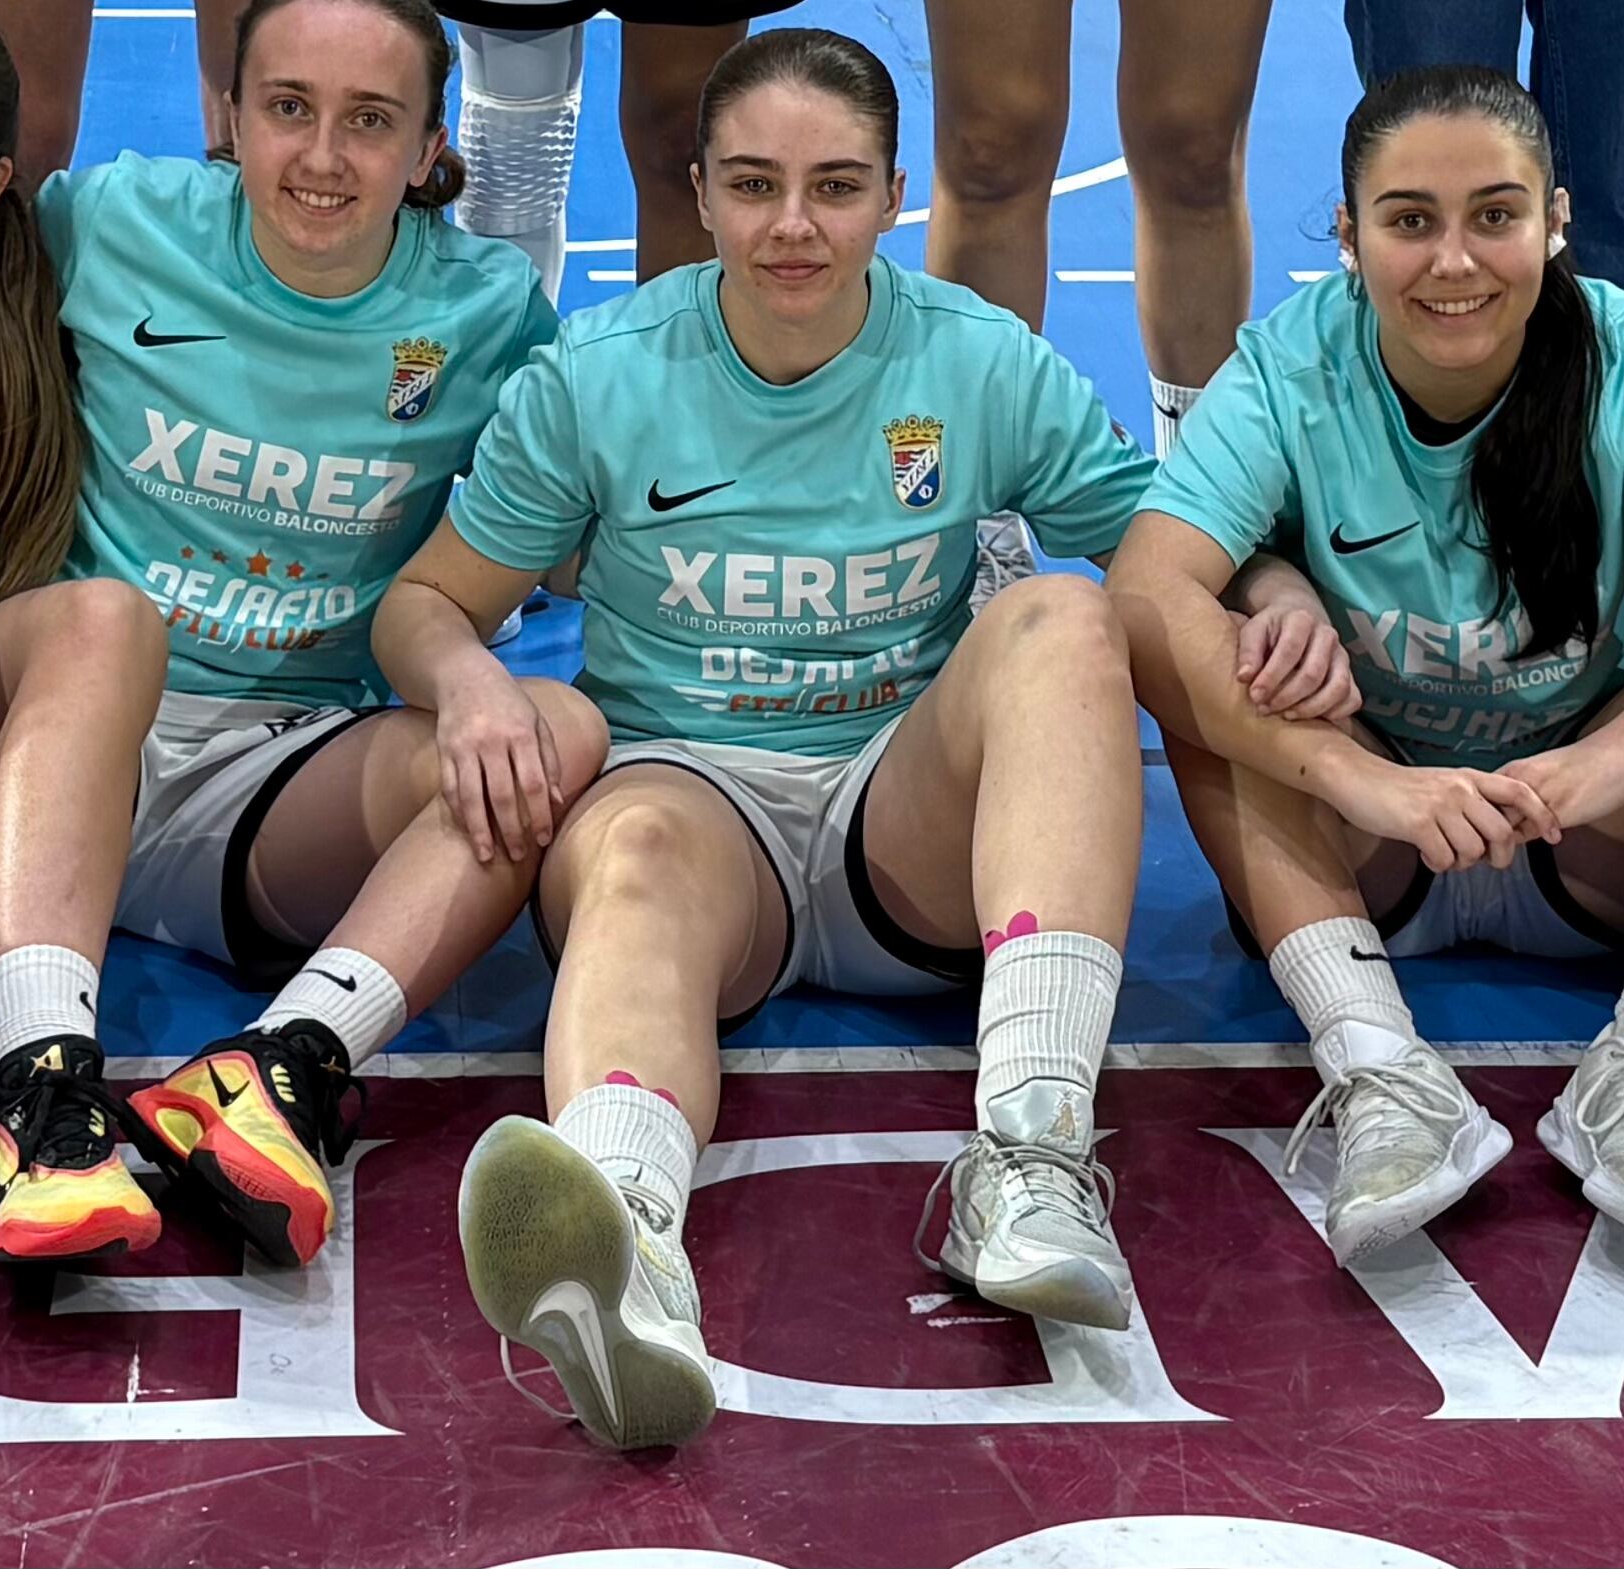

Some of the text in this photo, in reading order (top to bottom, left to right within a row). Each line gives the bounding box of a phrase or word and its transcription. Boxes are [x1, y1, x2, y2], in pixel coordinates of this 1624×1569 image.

[129, 408, 417, 521] XEREZ
[171, 483, 271, 523] DEPORTIVO
[274, 511, 401, 536] BALONCESTO
[657, 532, 941, 618] XEREZ
[656, 591, 942, 636] CLUB DEPORTIVO BALONCESTO
